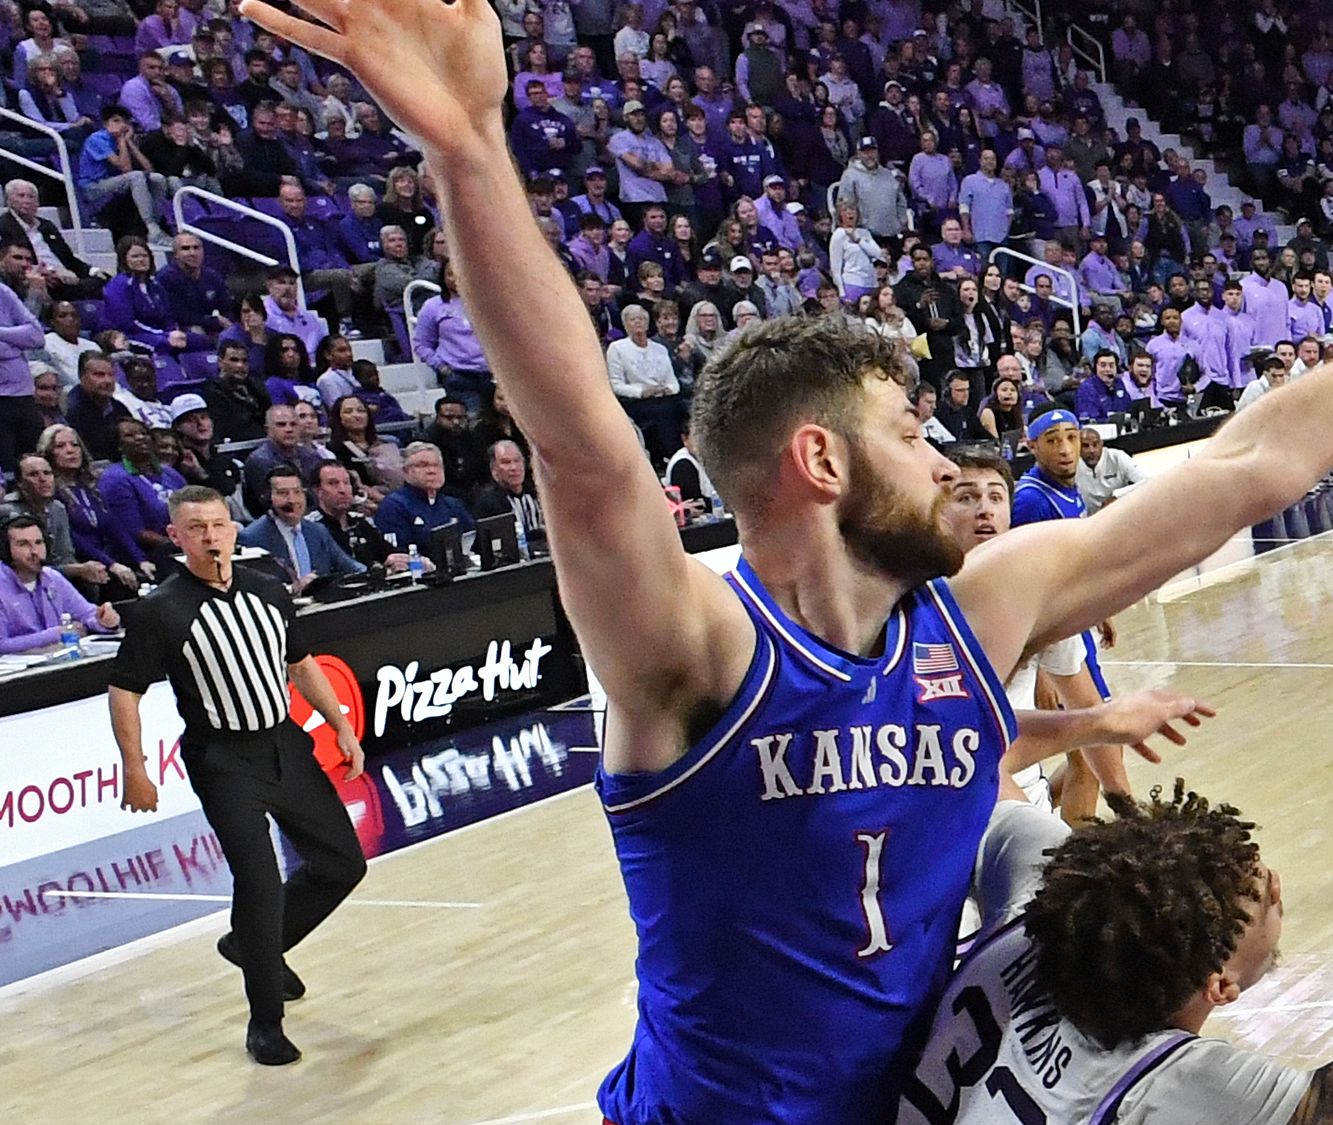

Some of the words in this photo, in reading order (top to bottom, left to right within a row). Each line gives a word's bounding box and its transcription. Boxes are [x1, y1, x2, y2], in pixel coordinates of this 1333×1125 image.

[374, 660, 476, 736] Pizza
[479, 638, 552, 701] Hut
[915, 673, 968, 702] XII
[750, 723, 980, 801] KANSAS
[857, 831, 893, 957] 1
